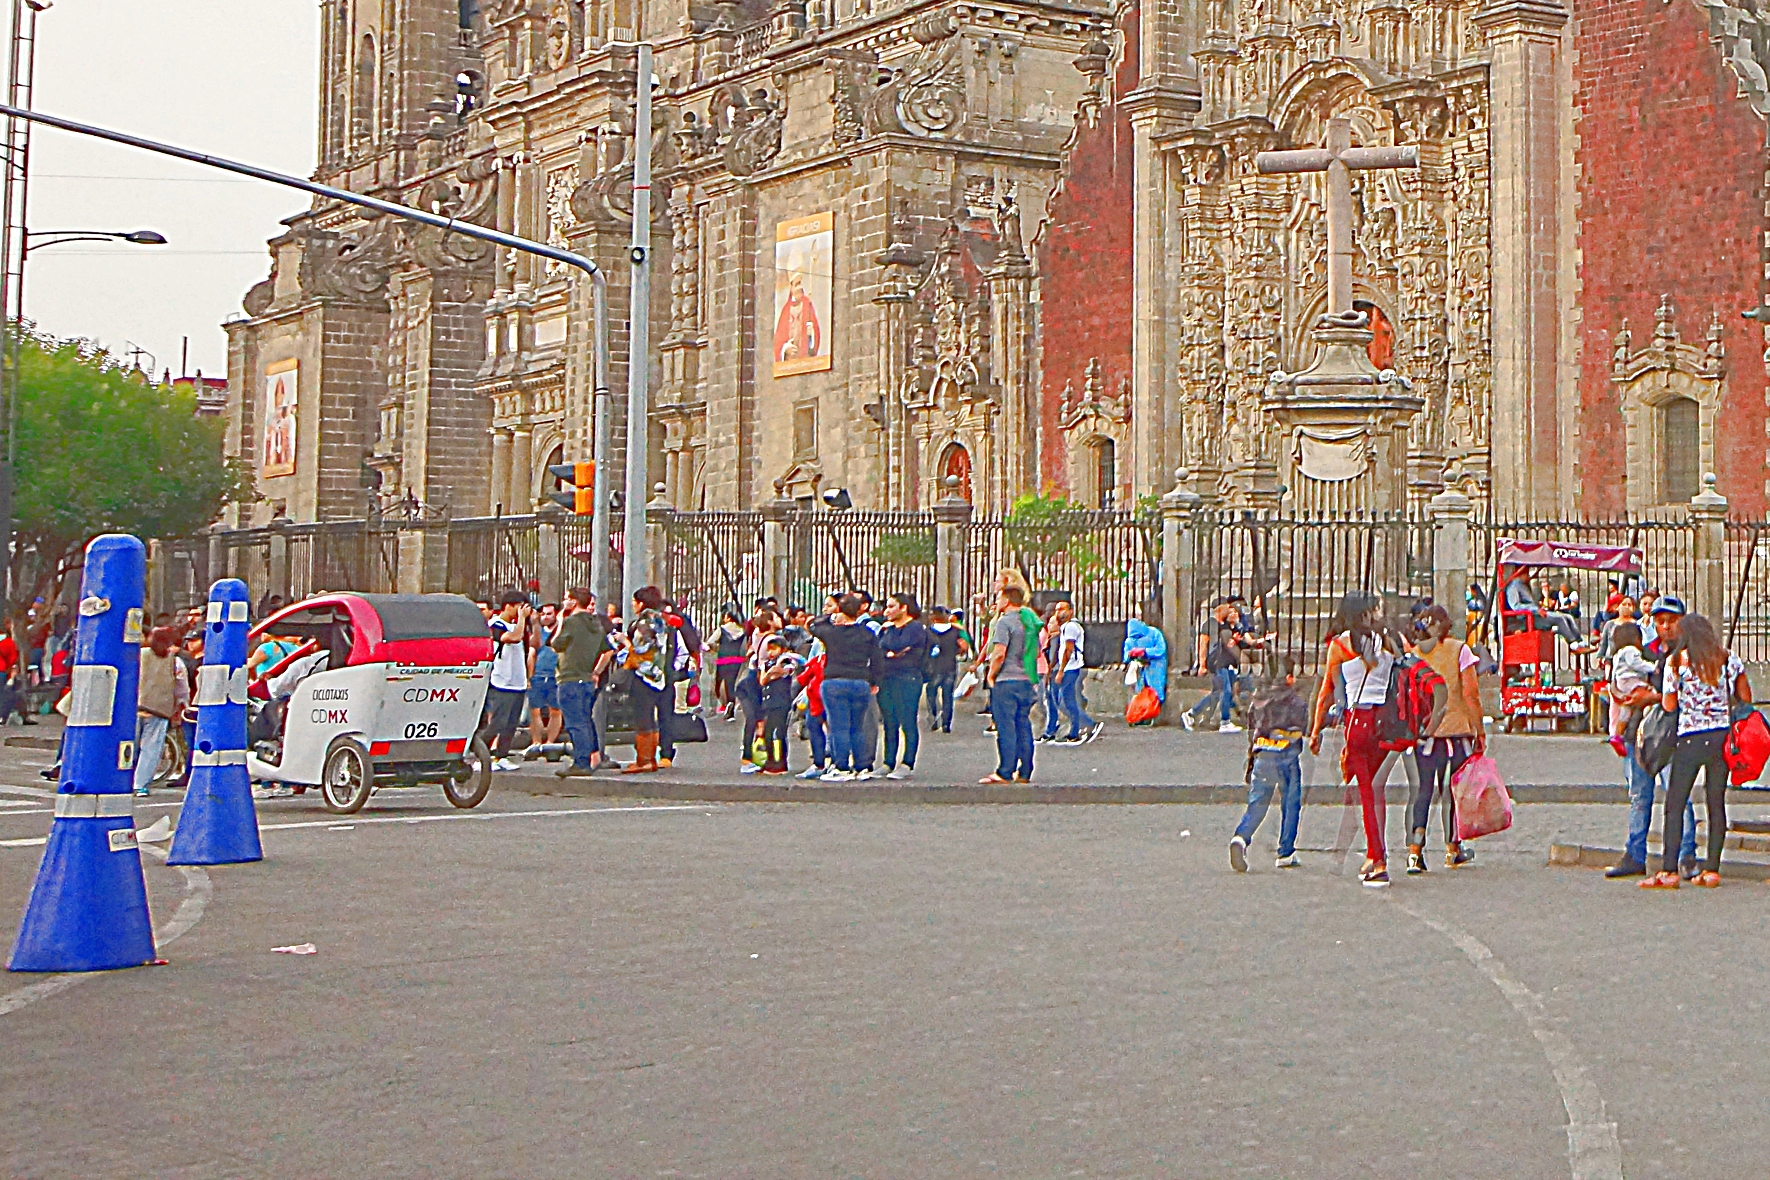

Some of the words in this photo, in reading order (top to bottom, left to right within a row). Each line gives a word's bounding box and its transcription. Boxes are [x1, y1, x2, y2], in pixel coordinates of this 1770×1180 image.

[312, 688, 349, 701] CICLOTAXIS
[403, 687, 461, 702] CDMX
[311, 708, 348, 724] CDMX
[404, 722, 439, 739] 026
[111, 831, 137, 844] CDM
